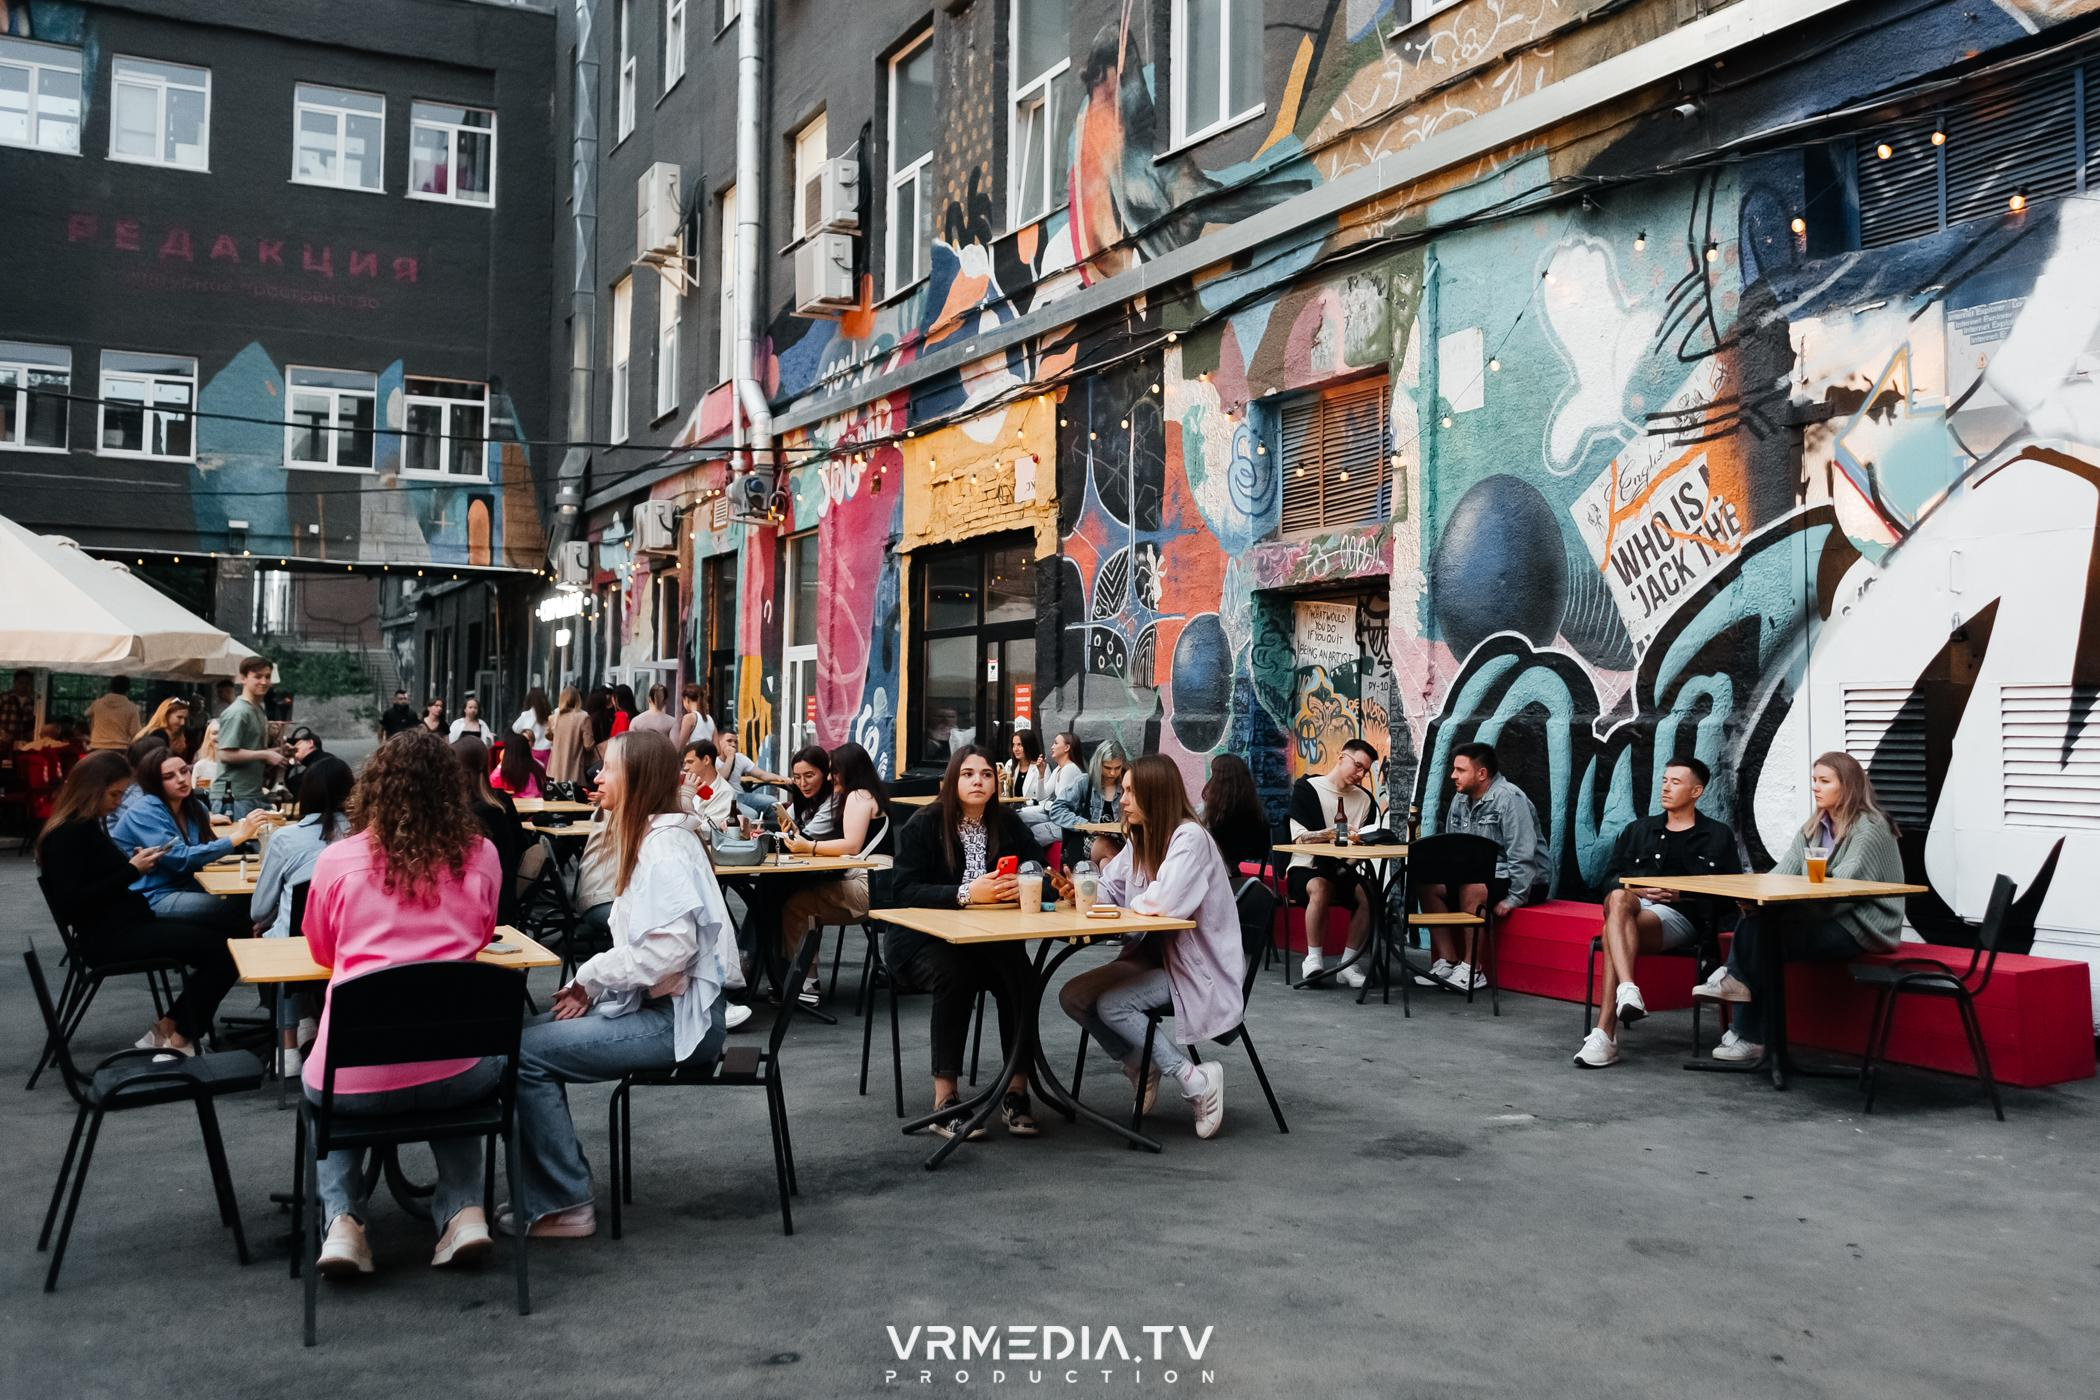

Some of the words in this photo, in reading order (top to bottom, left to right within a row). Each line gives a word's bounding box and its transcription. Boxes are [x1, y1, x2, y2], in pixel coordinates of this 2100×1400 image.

[66, 211, 418, 284] РЕДАКЦИЯ
[1611, 510, 1675, 587] WHO
[1669, 481, 1704, 530] IS
[1690, 500, 1740, 567] THE
[1307, 629, 1314, 641] IF
[1315, 631, 1326, 642] YOU
[1326, 633, 1343, 645] QUIT
[1315, 620, 1326, 631] YOU
[1327, 624, 1336, 633] DO
[1298, 643, 1318, 659] BEING
[1319, 649, 1328, 660] AN
